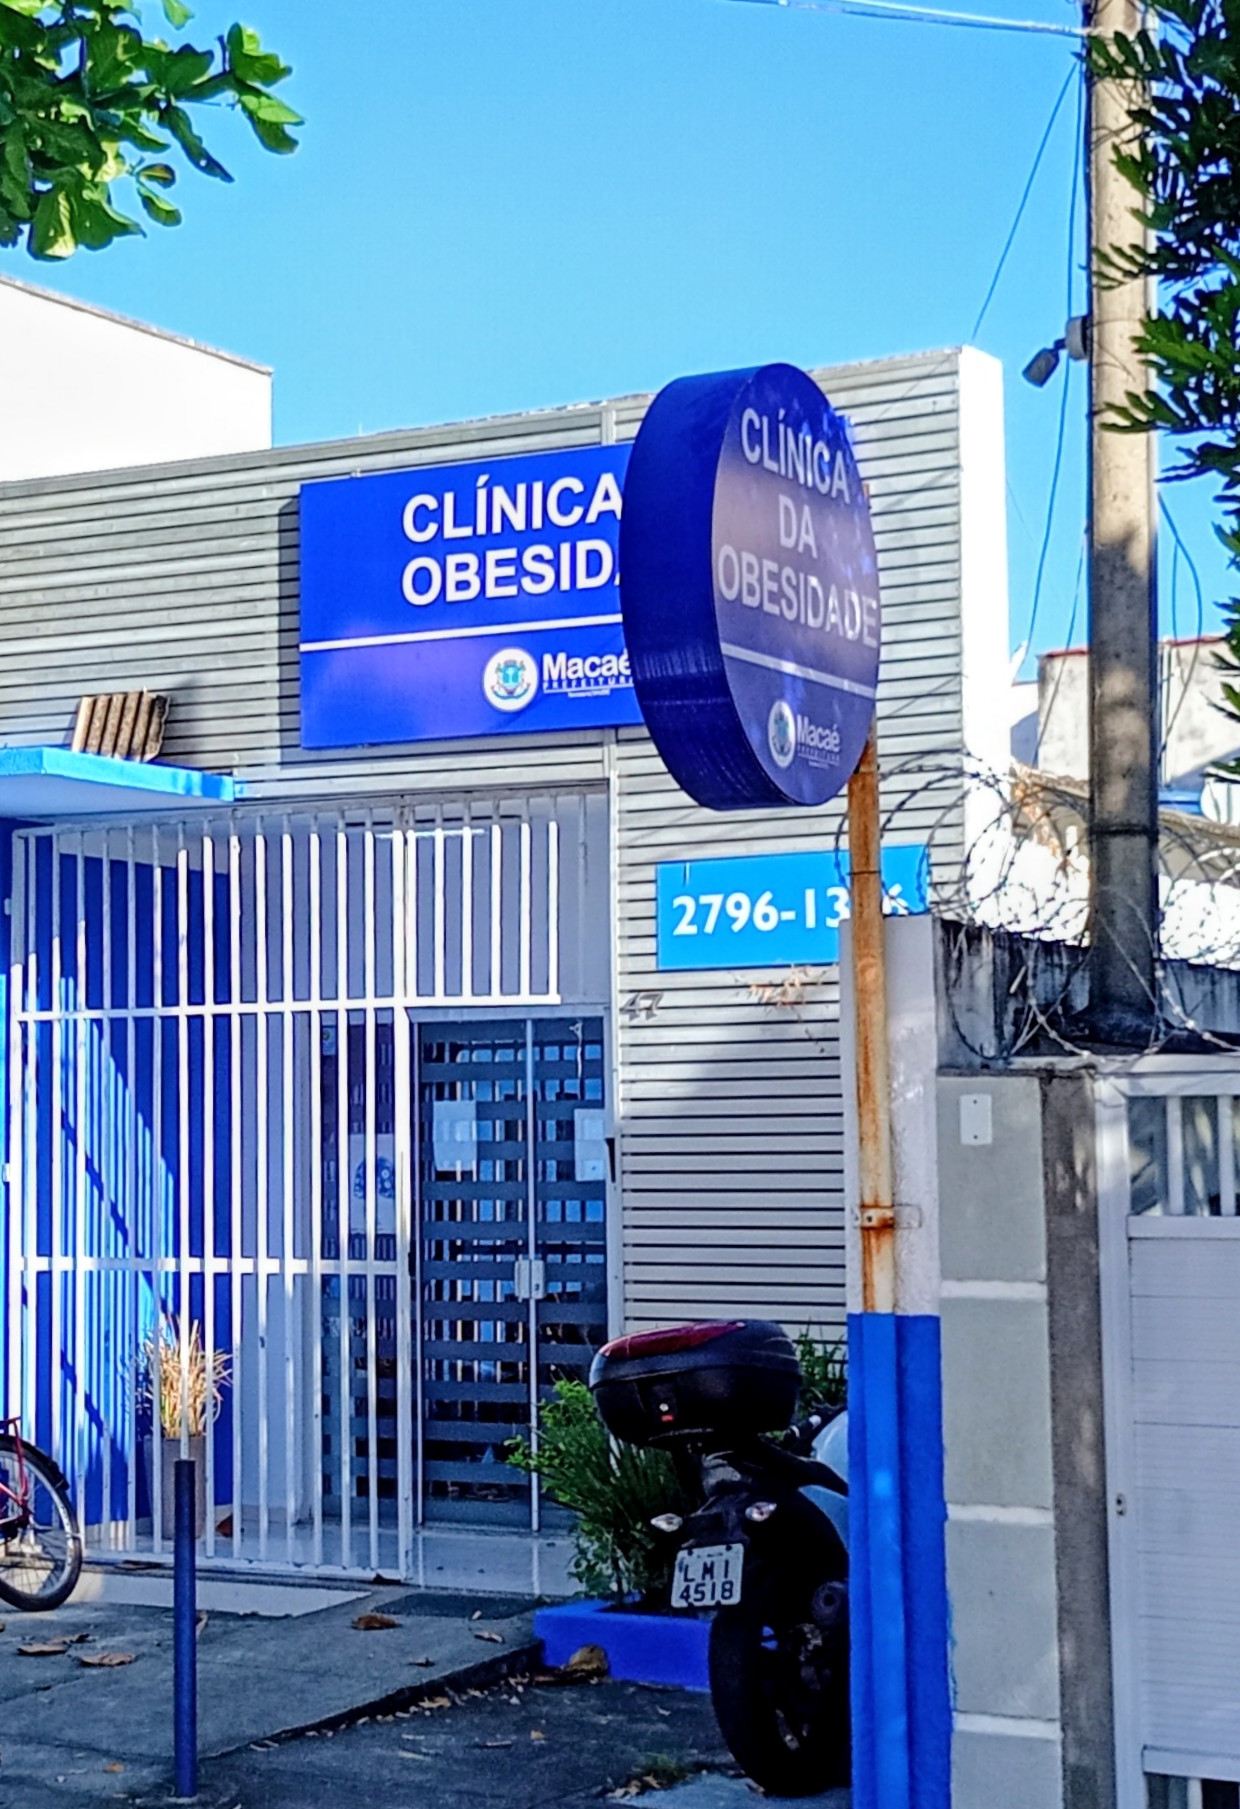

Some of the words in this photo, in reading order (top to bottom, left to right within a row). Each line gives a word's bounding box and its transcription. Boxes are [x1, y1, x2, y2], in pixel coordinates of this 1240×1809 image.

[741, 407, 851, 505] CLÍNICA
[402, 472, 623, 543] CLÍNICA
[778, 493, 818, 560] DA
[401, 538, 620, 606] OBESID
[717, 544, 879, 649] OBESIDADE
[796, 714, 840, 753] Macaé
[671, 882, 909, 936] 2796-136
[679, 1580, 734, 1602] 4518
